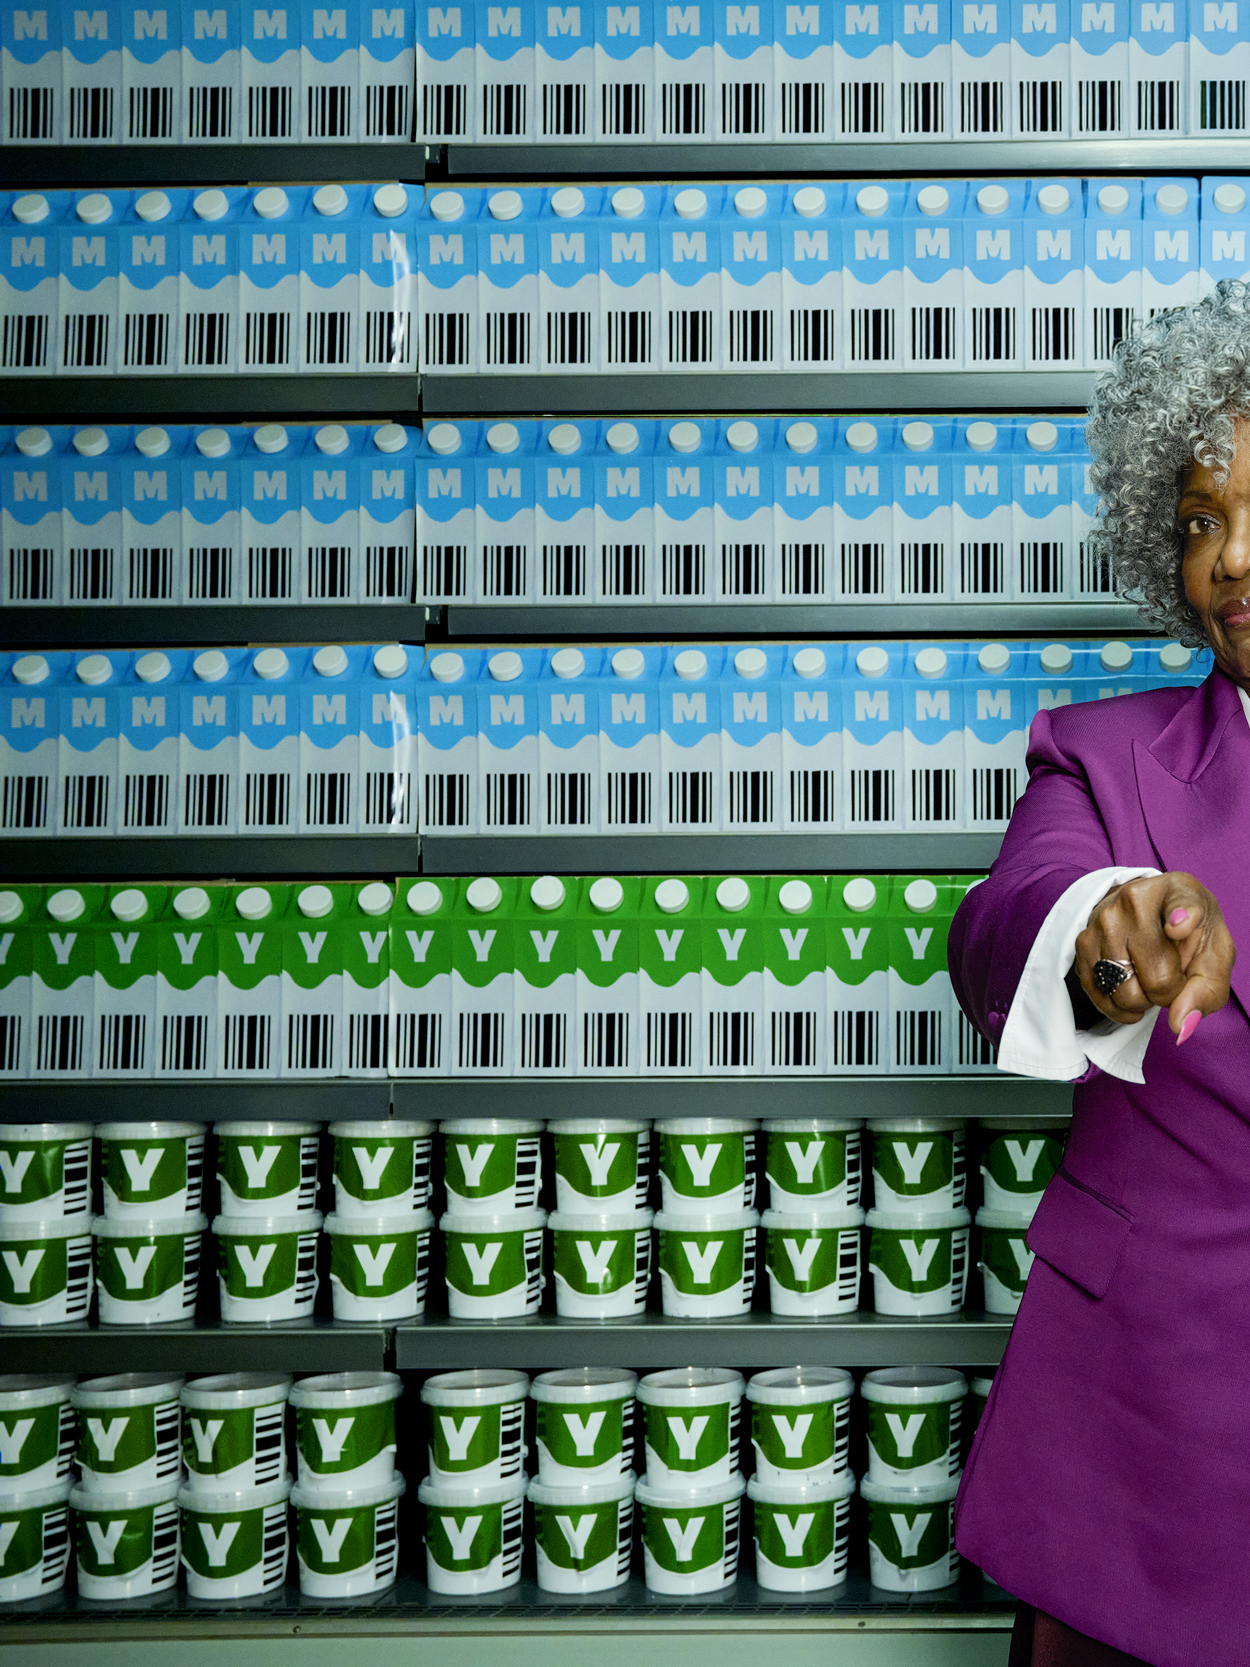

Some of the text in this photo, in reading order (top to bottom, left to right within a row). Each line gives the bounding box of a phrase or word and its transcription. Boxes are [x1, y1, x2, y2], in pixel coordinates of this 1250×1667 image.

[14, 11, 47, 40] M
[134, 10, 167, 39] M
[254, 10, 286, 39] M
[372, 9, 404, 38] M
[488, 7, 521, 37] M
[607, 7, 640, 36] M
[727, 6, 759, 35] M
[846, 5, 878, 35] M
[963, 4, 997, 34] M
[1082, 3, 1114, 32] M
[1141, 3, 1174, 32] M
[12, 237, 45, 267] M
[132, 236, 165, 265] M
[252, 234, 285, 264] M
[430, 235, 463, 264] M
[551, 233, 585, 263] M
[673, 232, 706, 262] M
[794, 231, 828, 261] M
[916, 228, 949, 258] M
[976, 230, 1010, 260] M
[1097, 230, 1130, 260] M
[1212, 231, 1245, 261] M
[74, 472, 107, 501] M
[194, 471, 227, 500] M
[314, 471, 346, 500] M
[428, 469, 461, 498] M
[548, 468, 580, 497] M
[667, 467, 700, 497] M
[727, 467, 759, 496] M
[846, 466, 879, 496] M
[965, 465, 998, 495] M
[72, 698, 105, 727] M
[193, 696, 226, 726] M
[313, 695, 346, 724] M
[490, 695, 524, 725] M
[612, 694, 645, 724] M
[733, 692, 767, 723] M
[794, 692, 828, 722] M
[916, 691, 950, 721] M
[49, 933, 77, 964] Y
[111, 932, 140, 963] Y
[173, 933, 202, 964] Y
[235, 932, 264, 964] Y
[298, 932, 327, 963] Y
[359, 931, 387, 963] Y
[405, 931, 434, 962] Y
[468, 930, 496, 962] Y
[530, 930, 559, 962] Y
[592, 930, 621, 961] Y
[655, 929, 684, 961] Y
[717, 929, 746, 960] Y
[780, 929, 808, 960] Y
[842, 928, 871, 959] Y
[904, 928, 933, 960] Y
[0, 1151, 35, 1193] Y
[121, 1149, 165, 1191] Y
[238, 1146, 281, 1188] Y
[352, 1147, 394, 1189] Y
[456, 1143, 495, 1186] Y
[579, 1143, 620, 1186] Y
[681, 1143, 722, 1186] Y
[785, 1141, 825, 1183] Y
[893, 1142, 933, 1184] Y
[1004, 1140, 1045, 1182] Y
[2, 1249, 45, 1293] Y
[114, 1245, 157, 1289] Y
[234, 1244, 277, 1287] Y
[353, 1243, 396, 1286] Y
[461, 1243, 503, 1285] Y
[575, 1240, 617, 1284] Y
[682, 1241, 723, 1284] Y
[783, 1239, 822, 1281] Y
[899, 1239, 940, 1281] Y
[0, 1418, 35, 1464] Y
[88, 1417, 129, 1461] Y
[191, 1418, 223, 1462] Y
[312, 1418, 355, 1462] Y
[440, 1416, 481, 1460] Y
[563, 1411, 606, 1456] Y
[667, 1416, 709, 1460] Y
[771, 1414, 813, 1458] Y
[885, 1413, 926, 1457] Y
[86, 1520, 127, 1564] Y
[198, 1522, 241, 1566] Y
[311, 1518, 353, 1562] Y
[441, 1515, 483, 1560] Y
[555, 1514, 597, 1559] Y
[663, 1517, 705, 1562] Y
[773, 1513, 815, 1556] Y
[890, 1513, 932, 1557] Y
